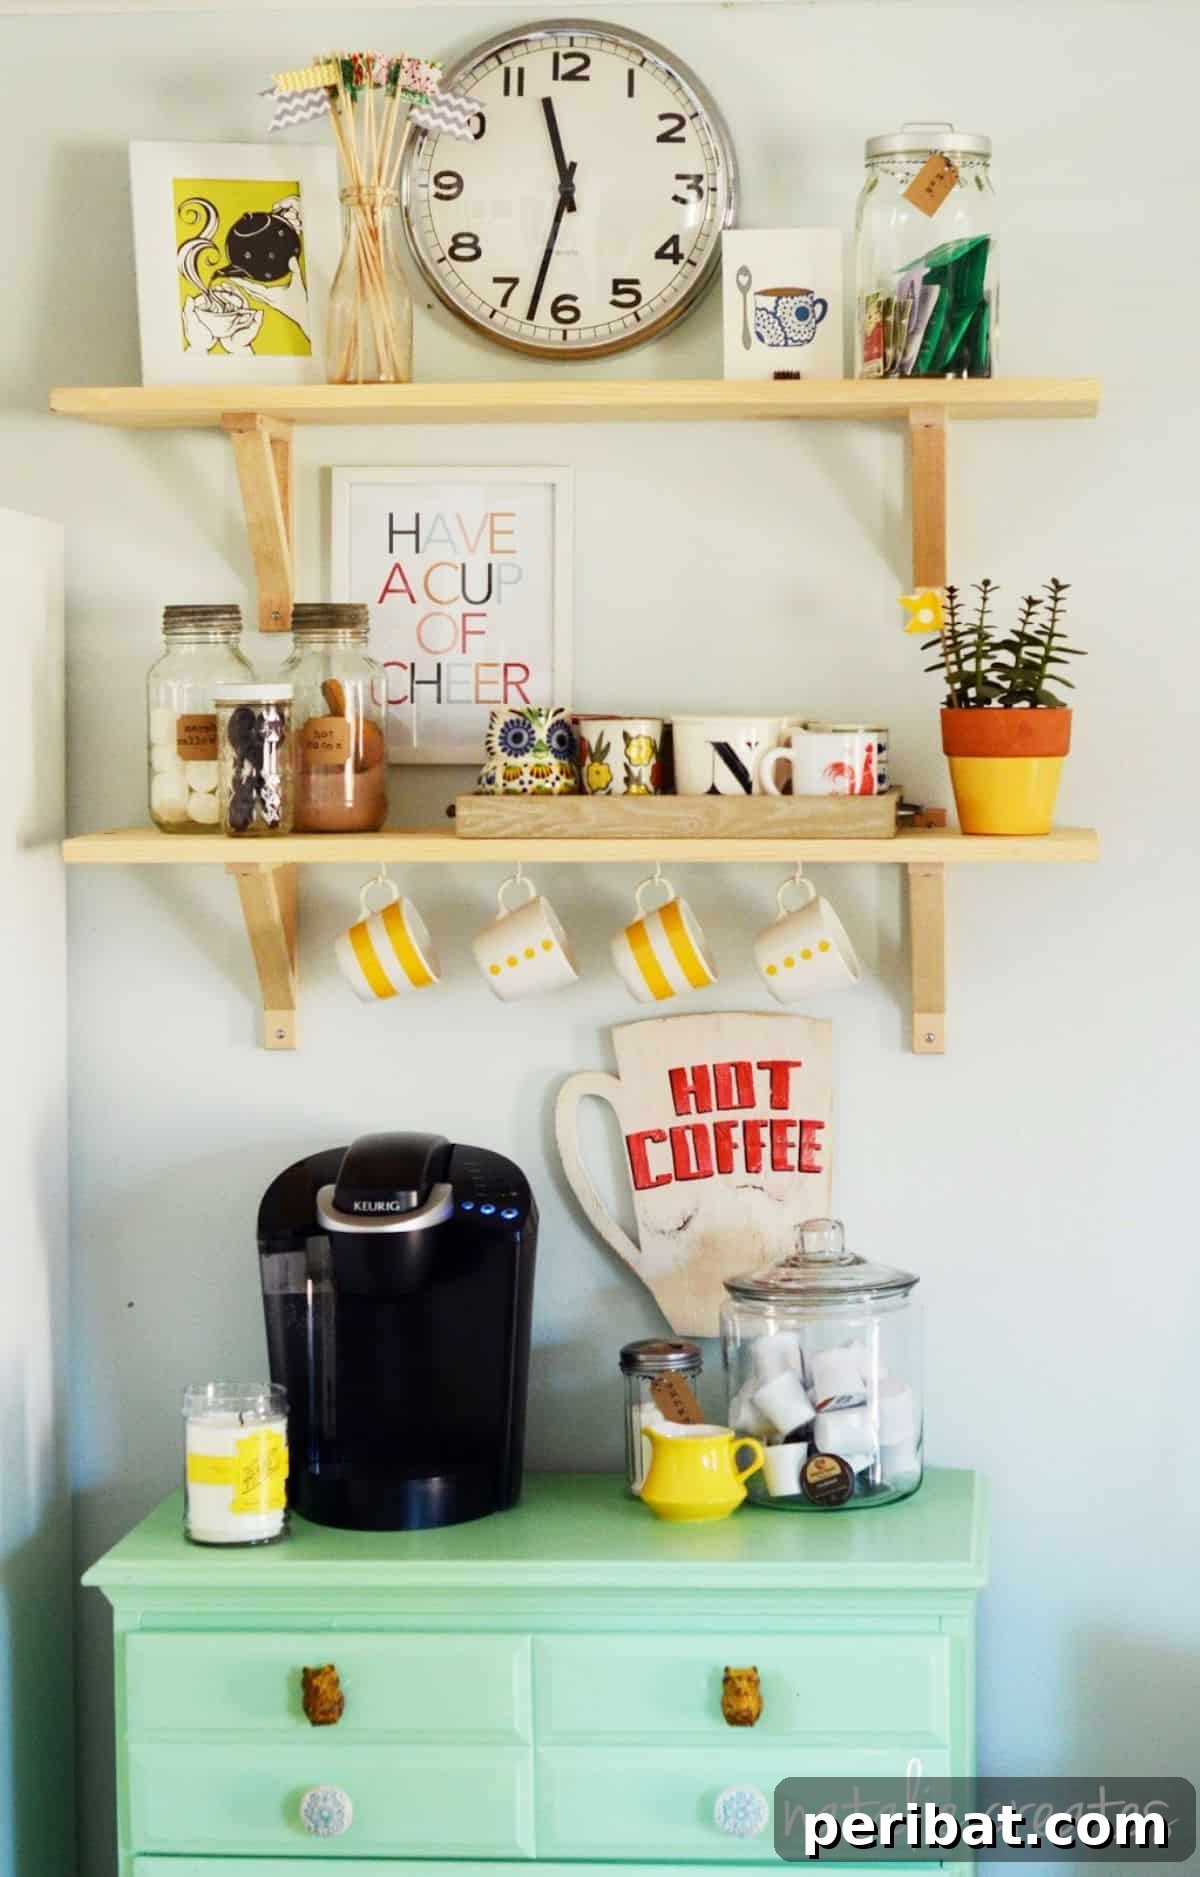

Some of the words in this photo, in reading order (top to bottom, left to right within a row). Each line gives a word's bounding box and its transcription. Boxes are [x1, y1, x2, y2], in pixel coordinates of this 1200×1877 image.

[503, 66, 525, 97] 11
[552, 51, 592, 82] 12
[627, 67, 635, 98] 1
[656, 112, 687, 143] 2
[432, 169, 465, 201] 9
[671, 173, 705, 206] 3
[447, 231, 483, 263] 8
[654, 234, 686, 266] 4
[492, 276, 520, 308] 7
[609, 278, 643, 309] 5
[549, 293, 582, 325] 6
[388, 511, 517, 555] HAVE
[377, 561, 417, 605] A
[423, 561, 524, 606] CUP
[416, 610, 488, 656] OF
[370, 660, 531, 706] CHEER
[668, 1060, 802, 1117] HOT
[625, 1118, 825, 1191] COFFEE
[352, 1199, 401, 1212] KEURIG
